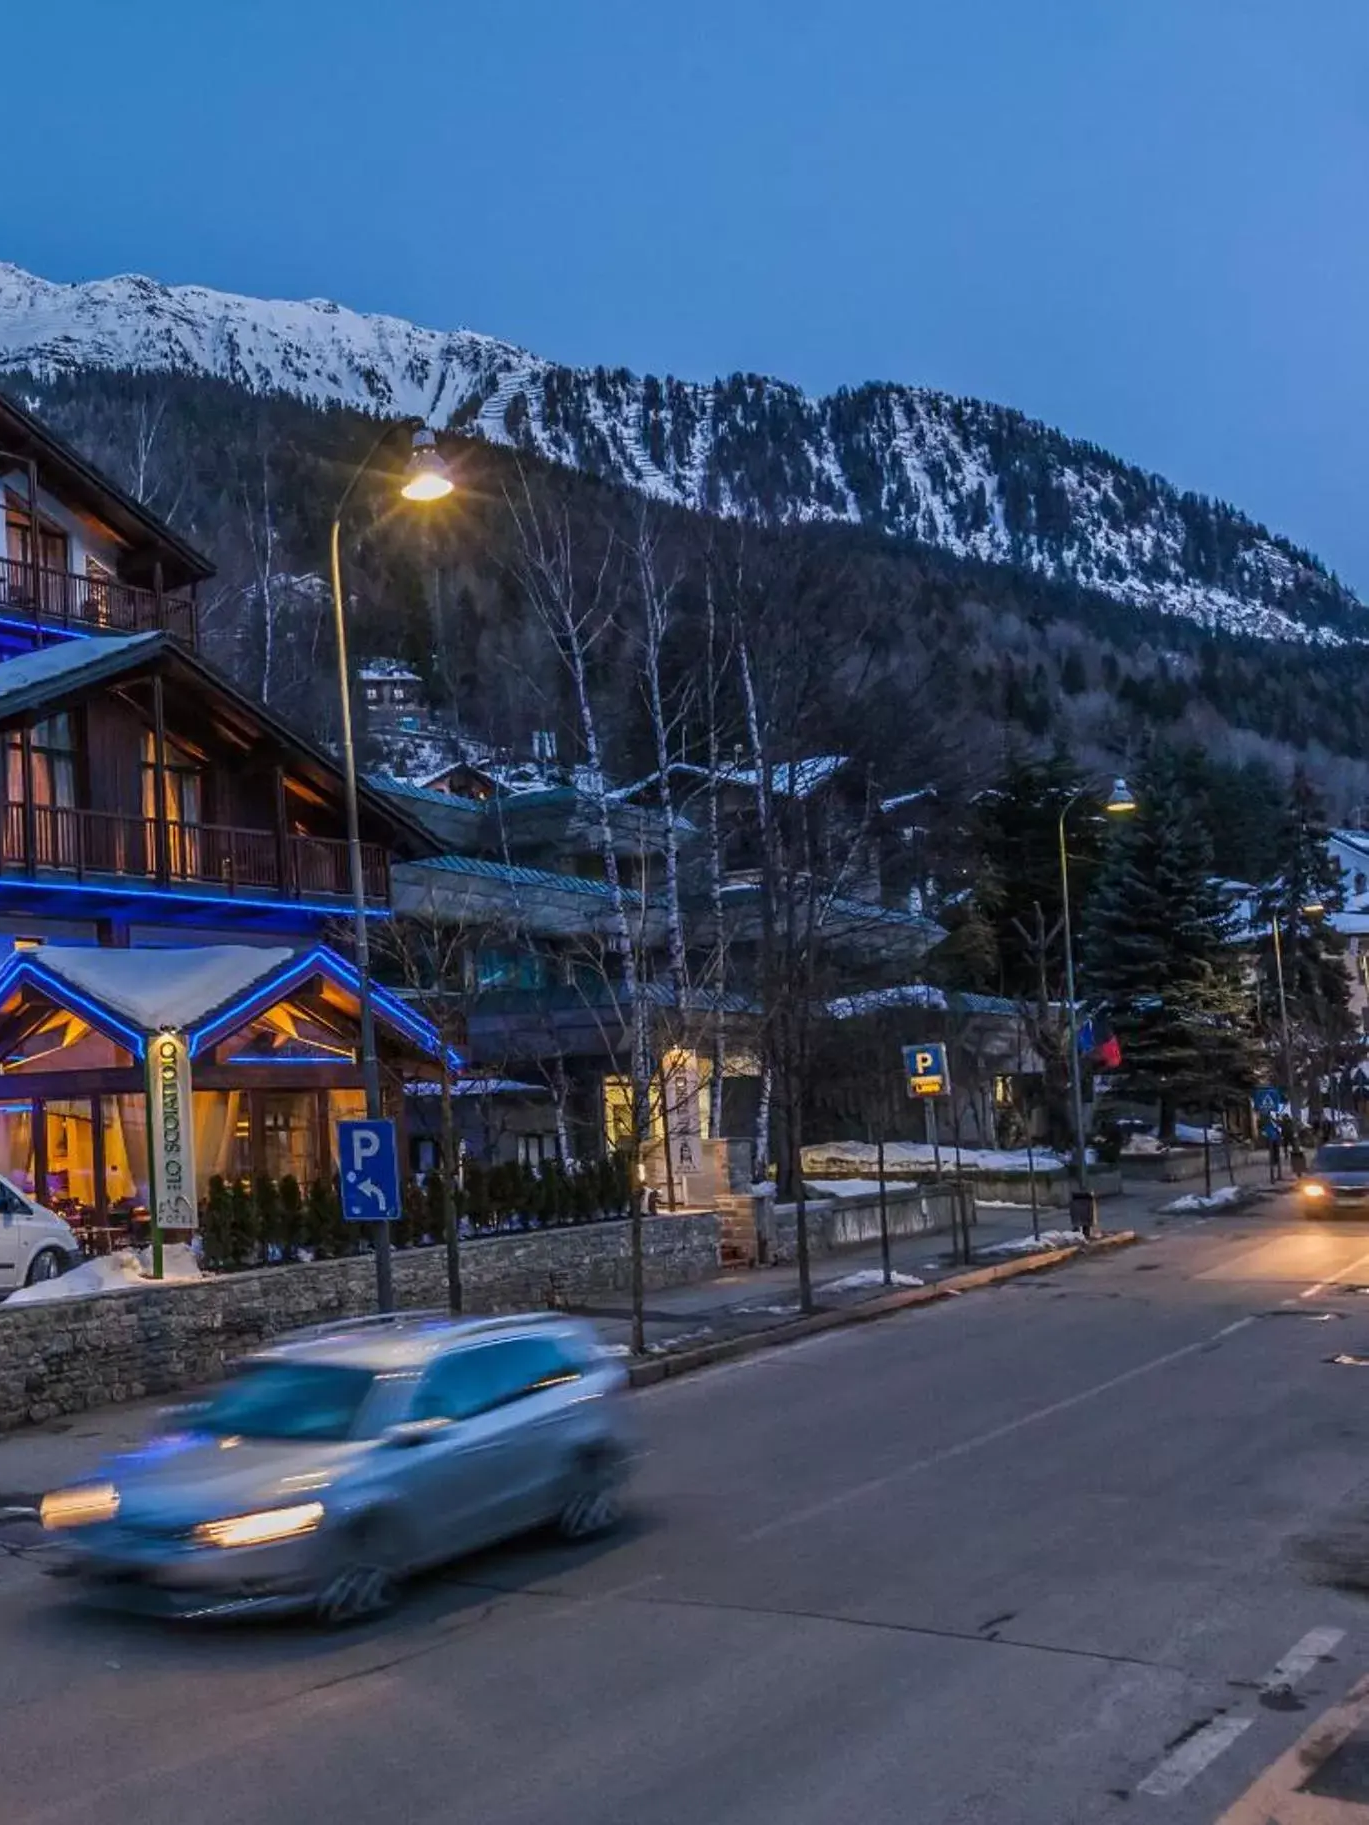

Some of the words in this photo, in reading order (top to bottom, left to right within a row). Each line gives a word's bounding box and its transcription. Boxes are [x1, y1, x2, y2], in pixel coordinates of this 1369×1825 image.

[915, 1052, 933, 1074] P
[160, 1041, 180, 1153] SCOIATTOLO
[352, 1129, 380, 1171] P
[165, 1160, 181, 1183] LO
